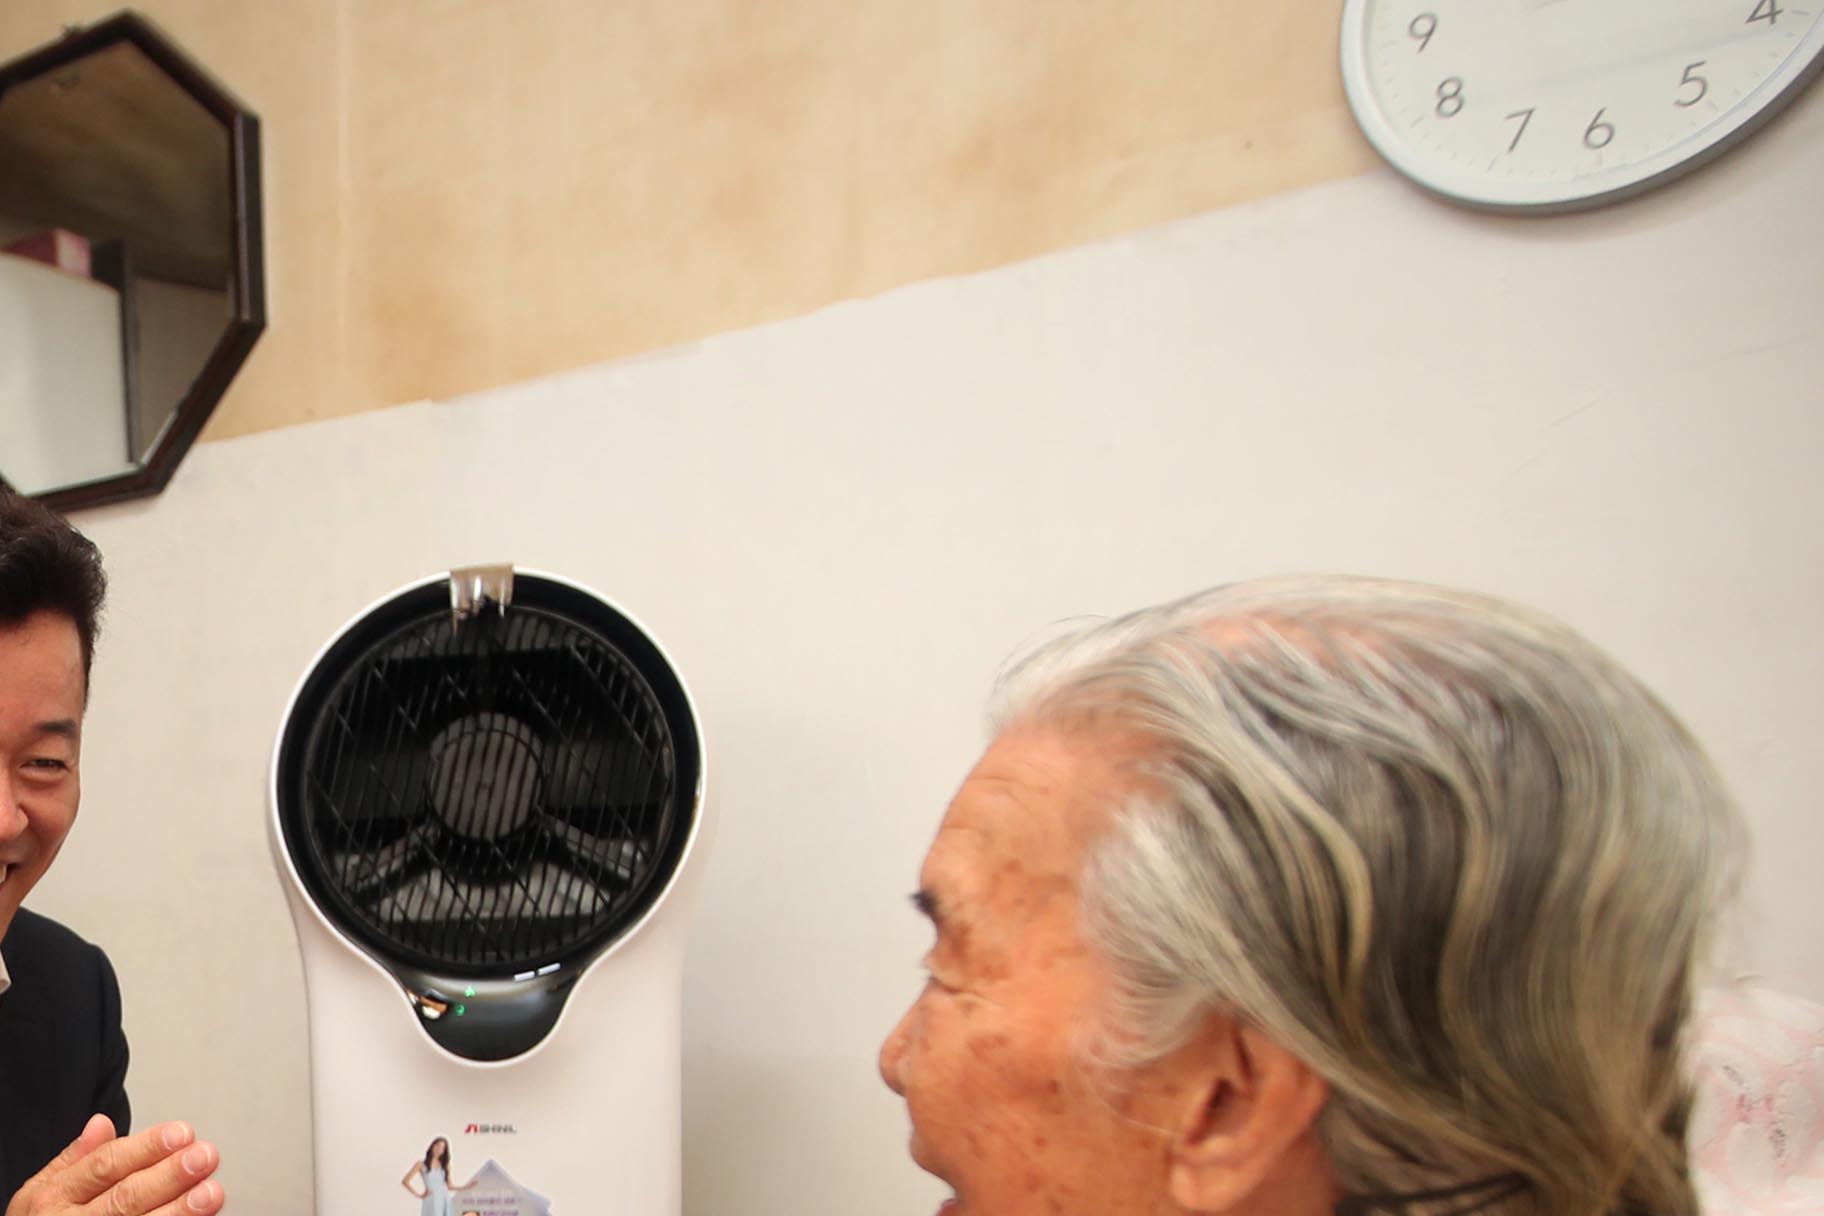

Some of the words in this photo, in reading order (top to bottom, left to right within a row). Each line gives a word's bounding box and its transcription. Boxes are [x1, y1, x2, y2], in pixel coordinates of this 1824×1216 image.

[1408, 13, 1437, 52] 9
[1436, 77, 1464, 117] 8
[1674, 61, 1707, 107] 5
[1505, 108, 1535, 153] 7
[1583, 108, 1615, 149] 6
